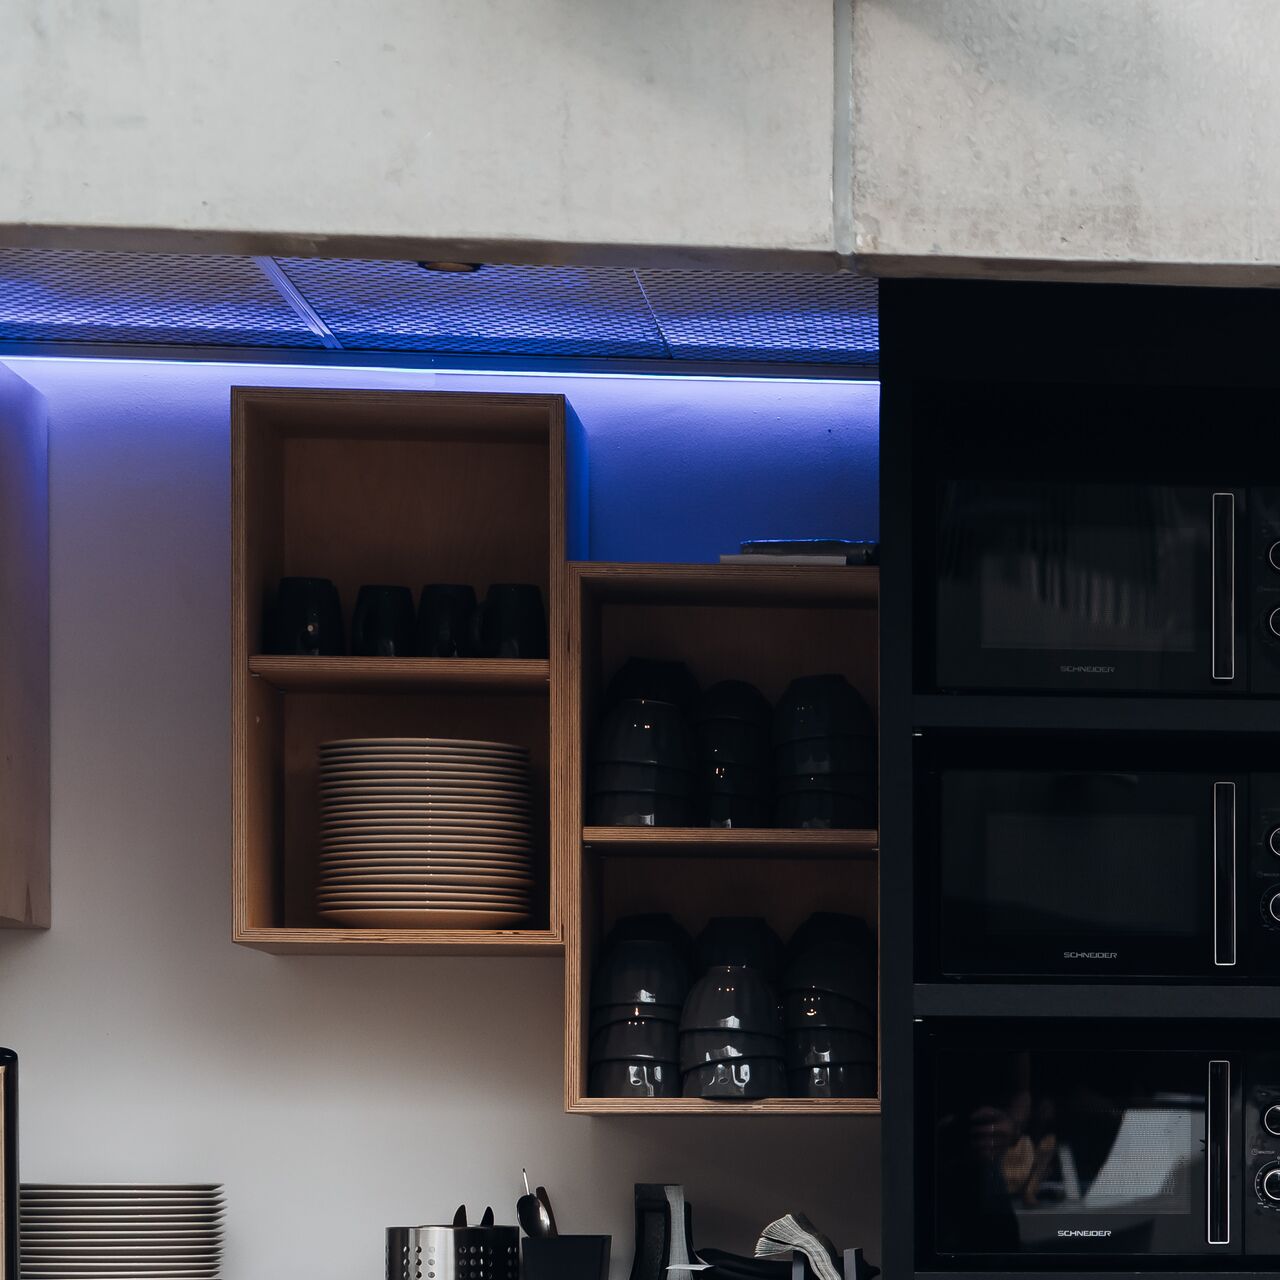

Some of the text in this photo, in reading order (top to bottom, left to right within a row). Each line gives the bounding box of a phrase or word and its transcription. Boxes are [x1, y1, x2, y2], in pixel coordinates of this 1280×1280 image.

[1059, 664, 1116, 674] SCHNEIDER
[1063, 951, 1118, 960] SCHNEIDER
[1057, 1229, 1112, 1238] SCHNEIDER
